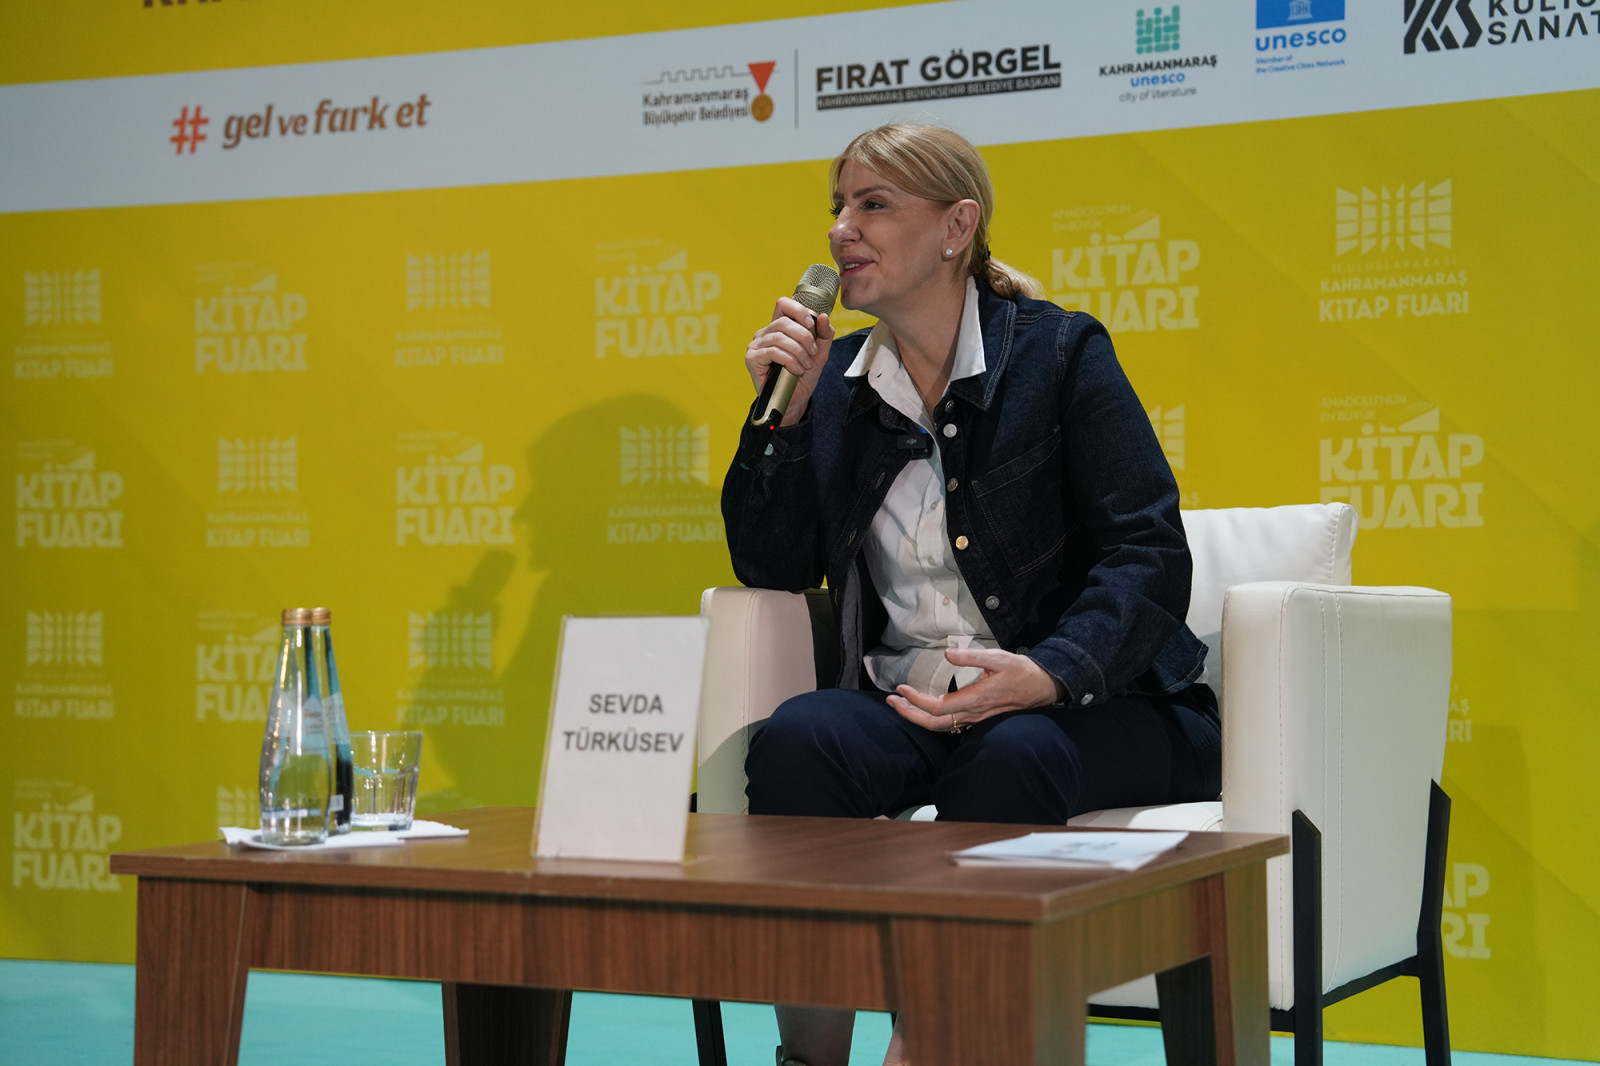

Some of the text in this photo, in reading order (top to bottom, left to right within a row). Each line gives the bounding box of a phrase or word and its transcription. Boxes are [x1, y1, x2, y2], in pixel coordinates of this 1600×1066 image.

[1255, 28, 1347, 51] unesco
[816, 44, 1061, 92] FIRAT GÖRGEL
[1099, 55, 1217, 76] KAHRAMANMARAŞ
[1130, 72, 1186, 88] unesco
[642, 88, 749, 107] Kahramanmaraş
[1118, 86, 1197, 103] city of literature
[222, 104, 274, 151] gel
[278, 113, 309, 137] ve
[314, 96, 390, 134] fark
[395, 93, 431, 129] et
[1051, 232, 1200, 291] KİTAP
[1320, 269, 1468, 293] KAHRAMANMARAŞ
[193, 285, 308, 334] KİTAP
[594, 264, 722, 317] KİTAP
[1396, 291, 1469, 318] FUARI
[194, 333, 308, 375] FUARI
[594, 313, 722, 361] FUARI
[1319, 424, 1485, 482] KİTAP
[15, 463, 124, 509] KİTAP
[394, 455, 516, 505] KİTAP
[15, 511, 124, 549] FUARI
[395, 505, 516, 547] FUARI
[195, 634, 278, 682] KİTA
[195, 684, 269, 723] FUA
[588, 693, 664, 715] SEVDA
[563, 726, 684, 753] TÜRKÜSEV
[13, 802, 123, 852] KİTAP
